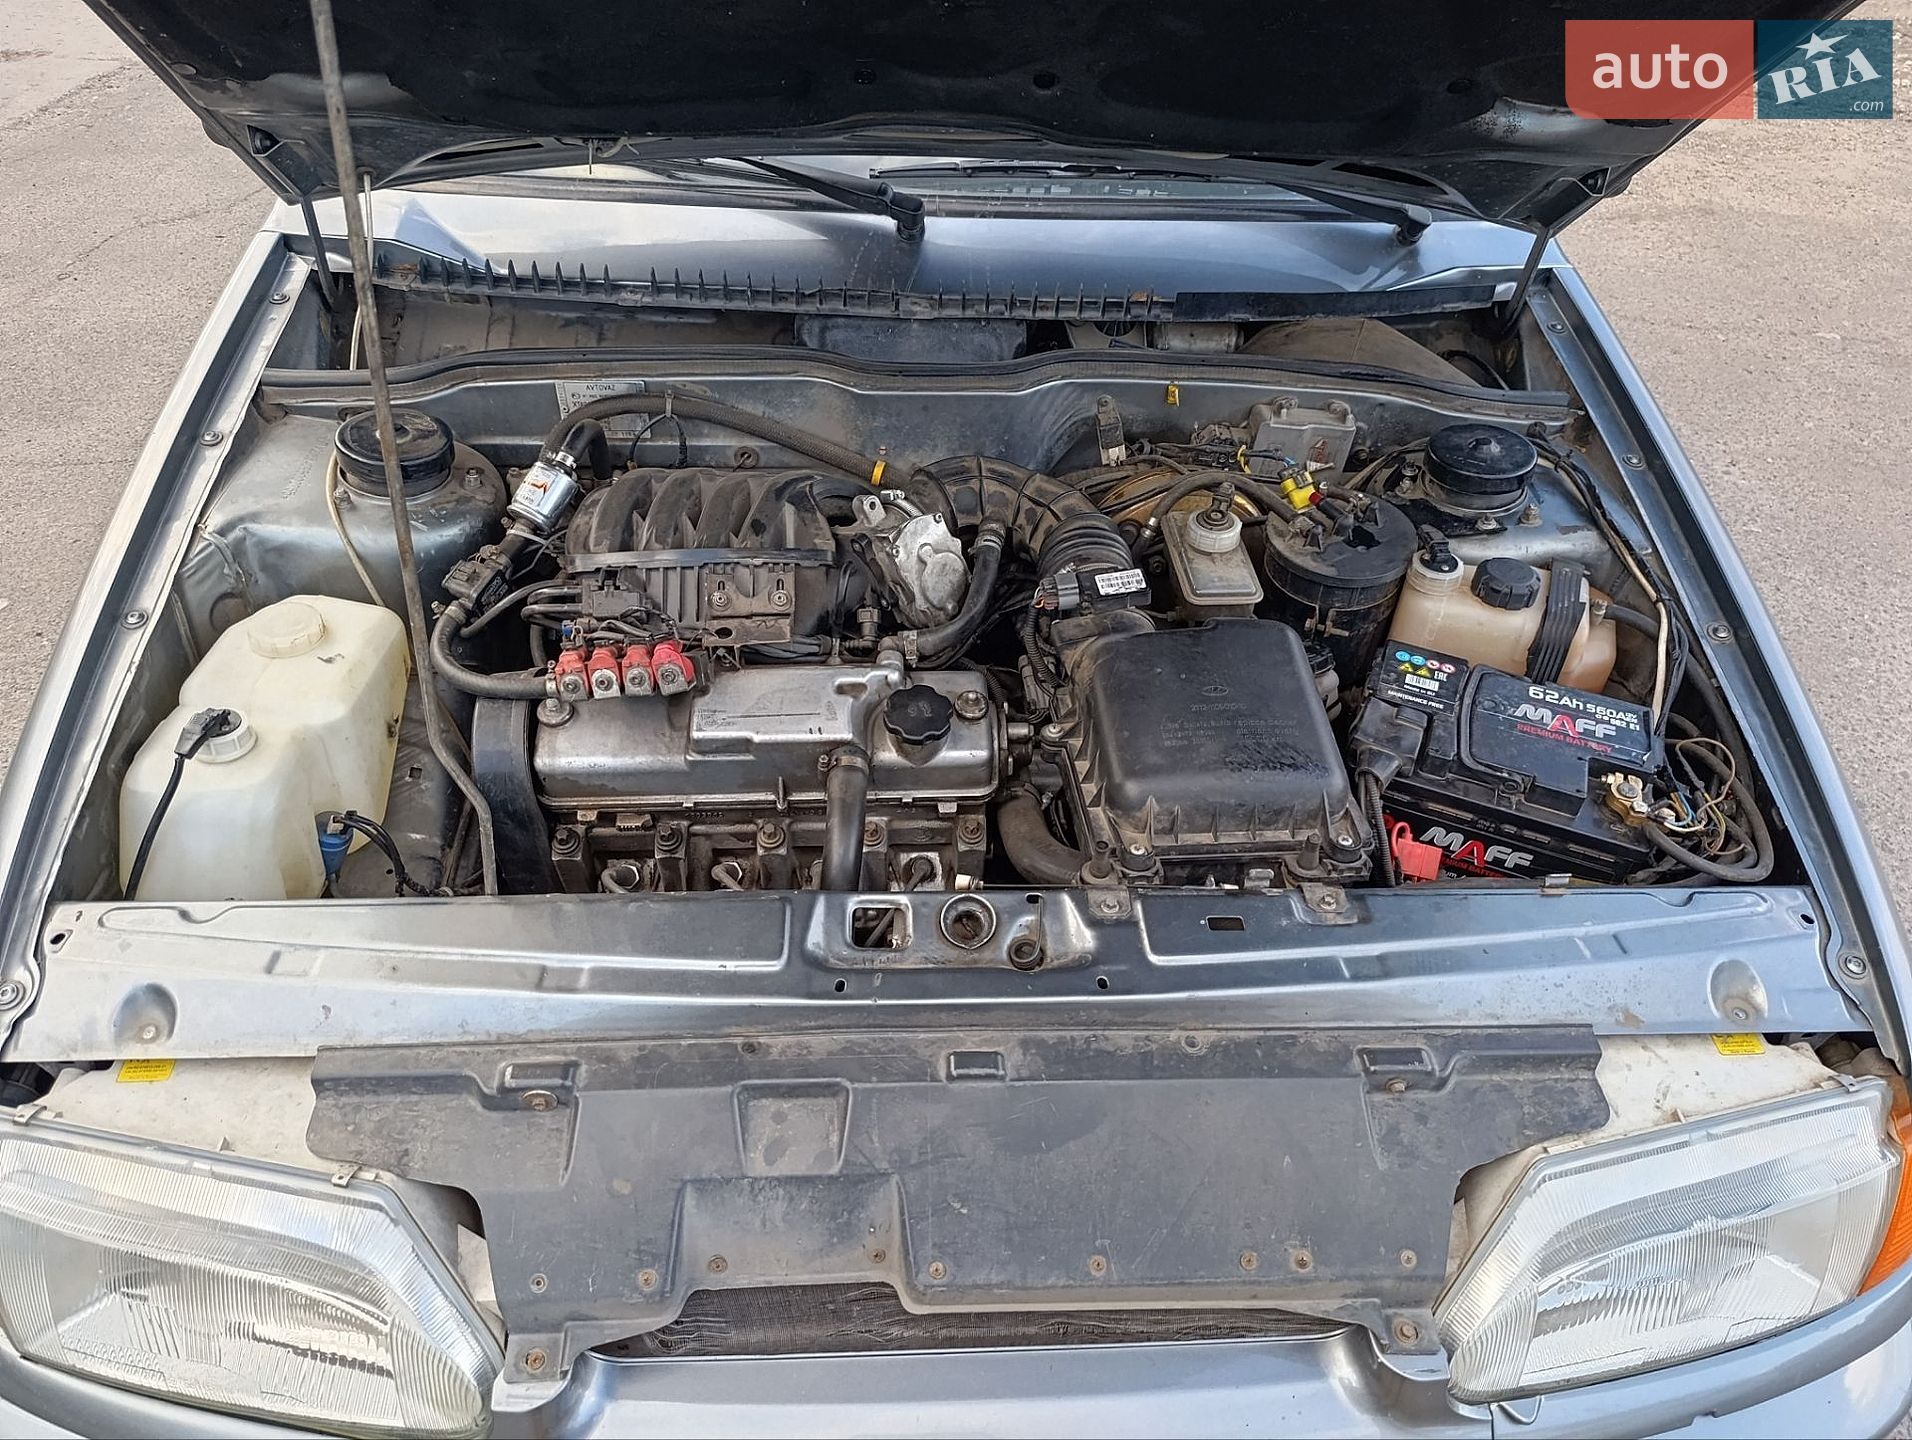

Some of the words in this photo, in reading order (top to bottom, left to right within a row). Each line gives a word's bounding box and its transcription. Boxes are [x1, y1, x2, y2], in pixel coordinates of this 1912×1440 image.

[586, 384, 616, 392] AVTOVAZ
[1528, 686, 1584, 711] 62Ah
[1513, 703, 1617, 738] MAFF
[1516, 722, 1565, 741] PREMIUM
[1565, 736, 1614, 754] BATTERY
[1419, 826, 1534, 868] MAFF
